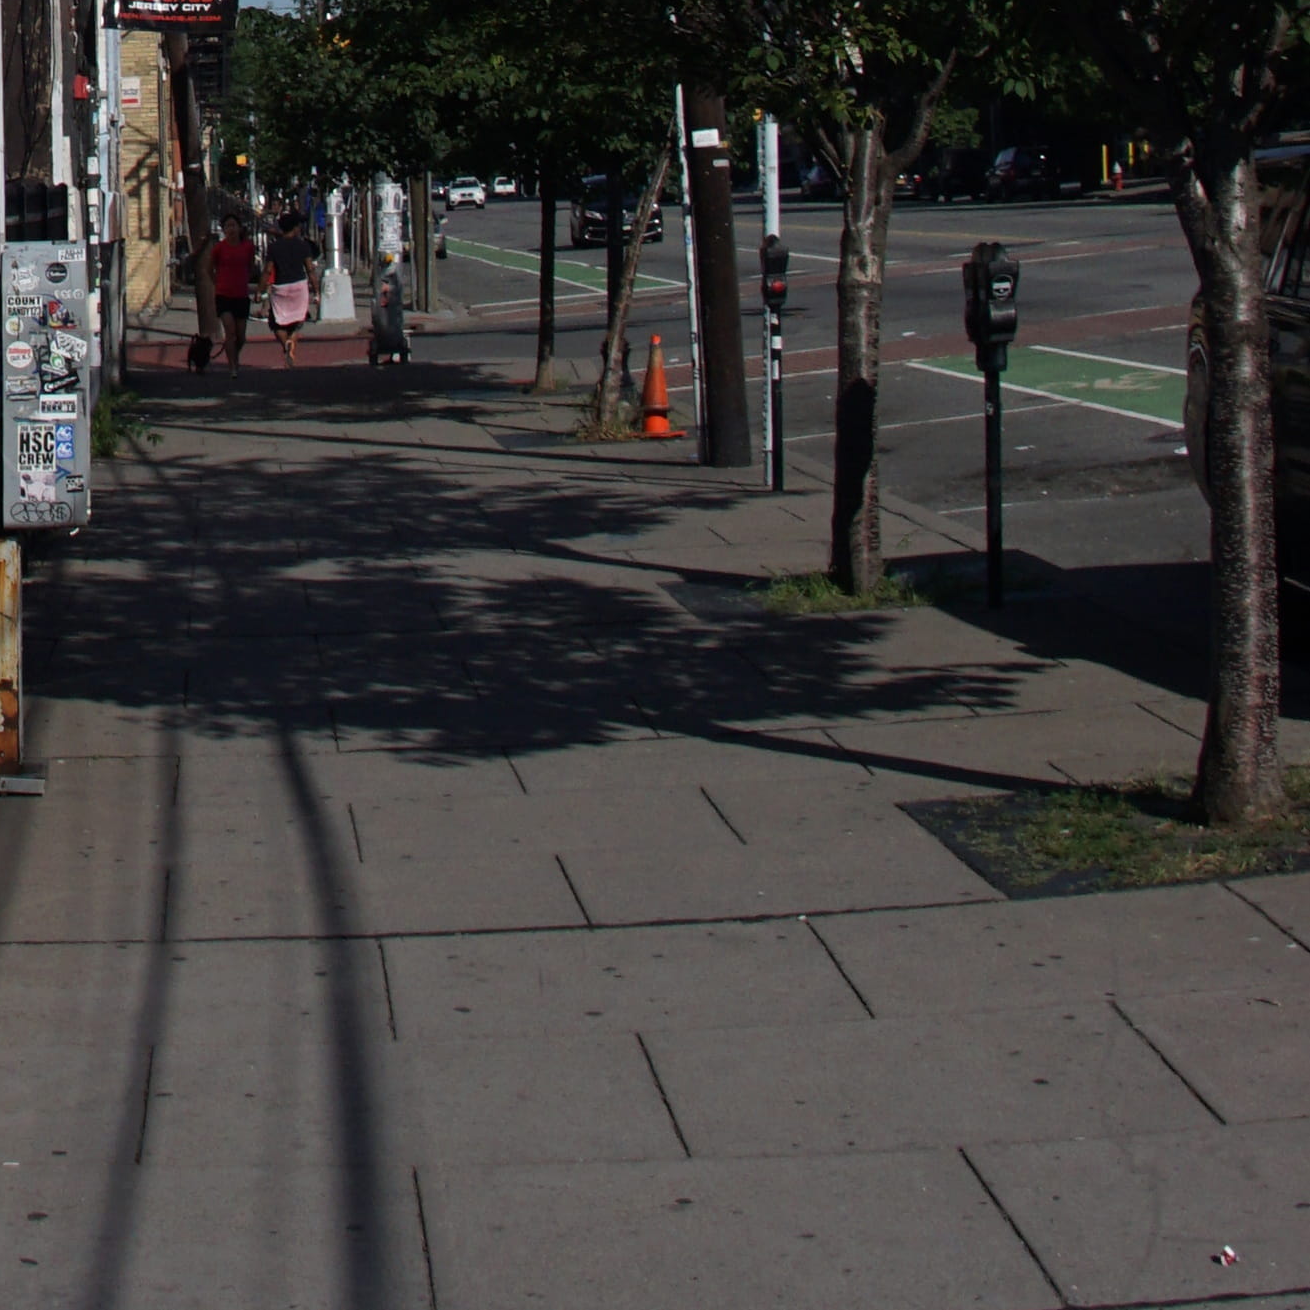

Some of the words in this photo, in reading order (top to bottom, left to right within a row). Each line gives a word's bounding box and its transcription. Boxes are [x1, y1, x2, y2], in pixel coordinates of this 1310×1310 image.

[128, 1, 179, 13] JERSEY
[182, 3, 211, 12] CITY
[7, 296, 41, 306] COUNT
[19, 431, 55, 453] HSC
[18, 453, 54, 465] CREW
